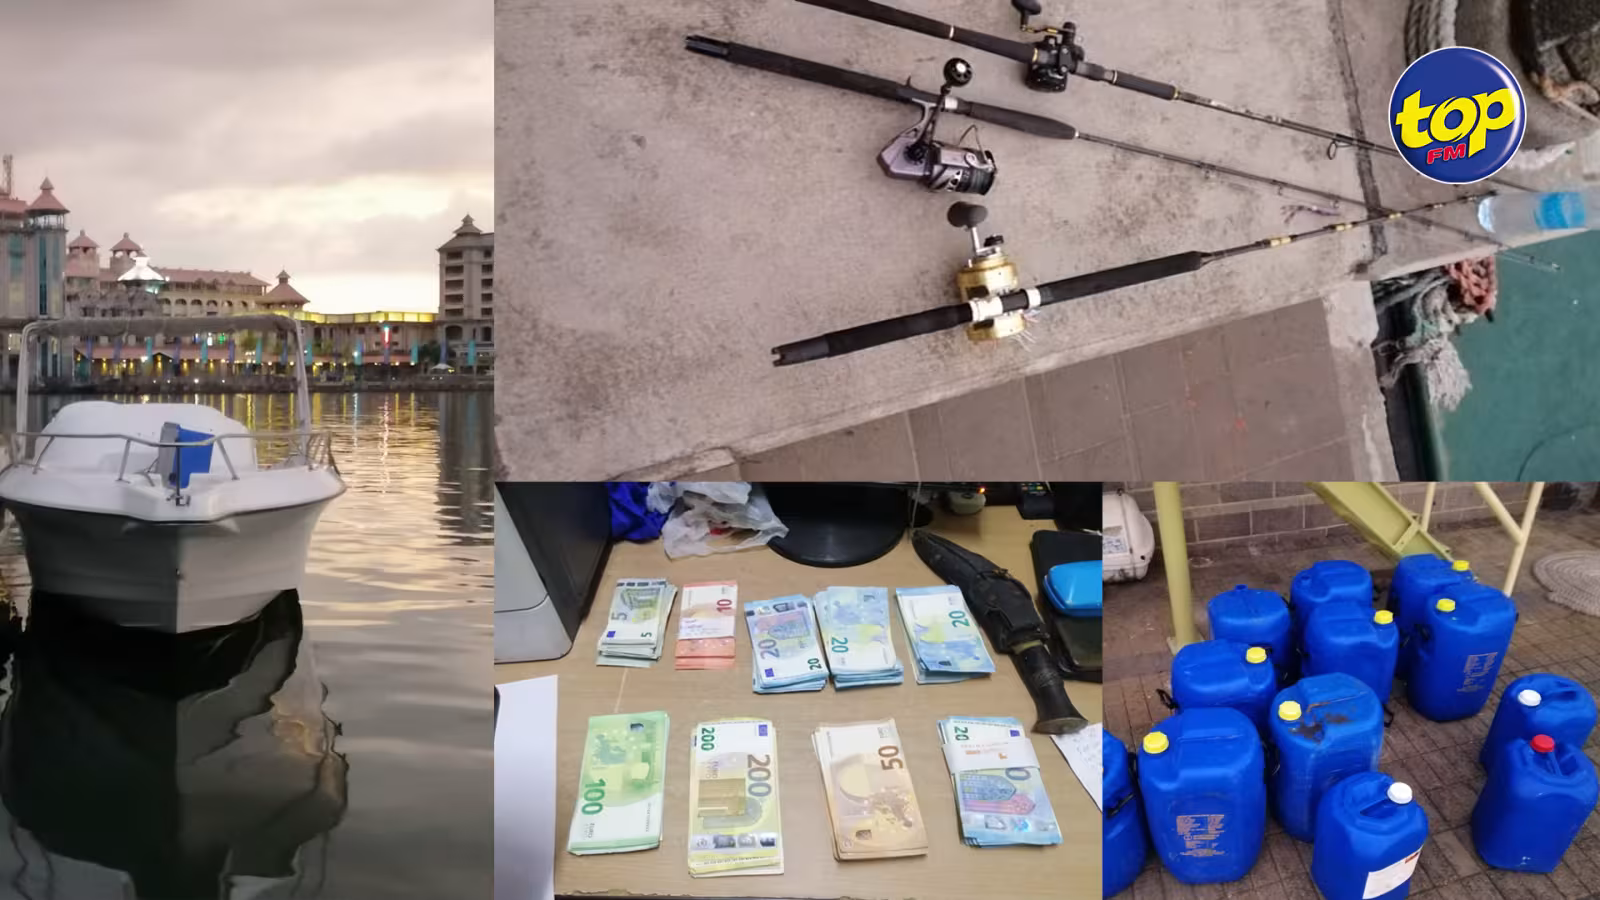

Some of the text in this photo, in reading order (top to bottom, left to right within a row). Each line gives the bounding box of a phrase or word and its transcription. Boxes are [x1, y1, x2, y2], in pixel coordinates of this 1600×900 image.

[716, 599, 733, 613] 10
[611, 612, 628, 621] 5
[948, 610, 970, 628] 20
[757, 639, 780, 660] 20
[831, 636, 849, 653] 20
[807, 657, 822, 671] 20
[700, 727, 715, 751] 200
[954, 726, 969, 741] 20
[878, 745, 903, 770] 50
[747, 754, 772, 797] 200
[581, 778, 606, 815] 100
